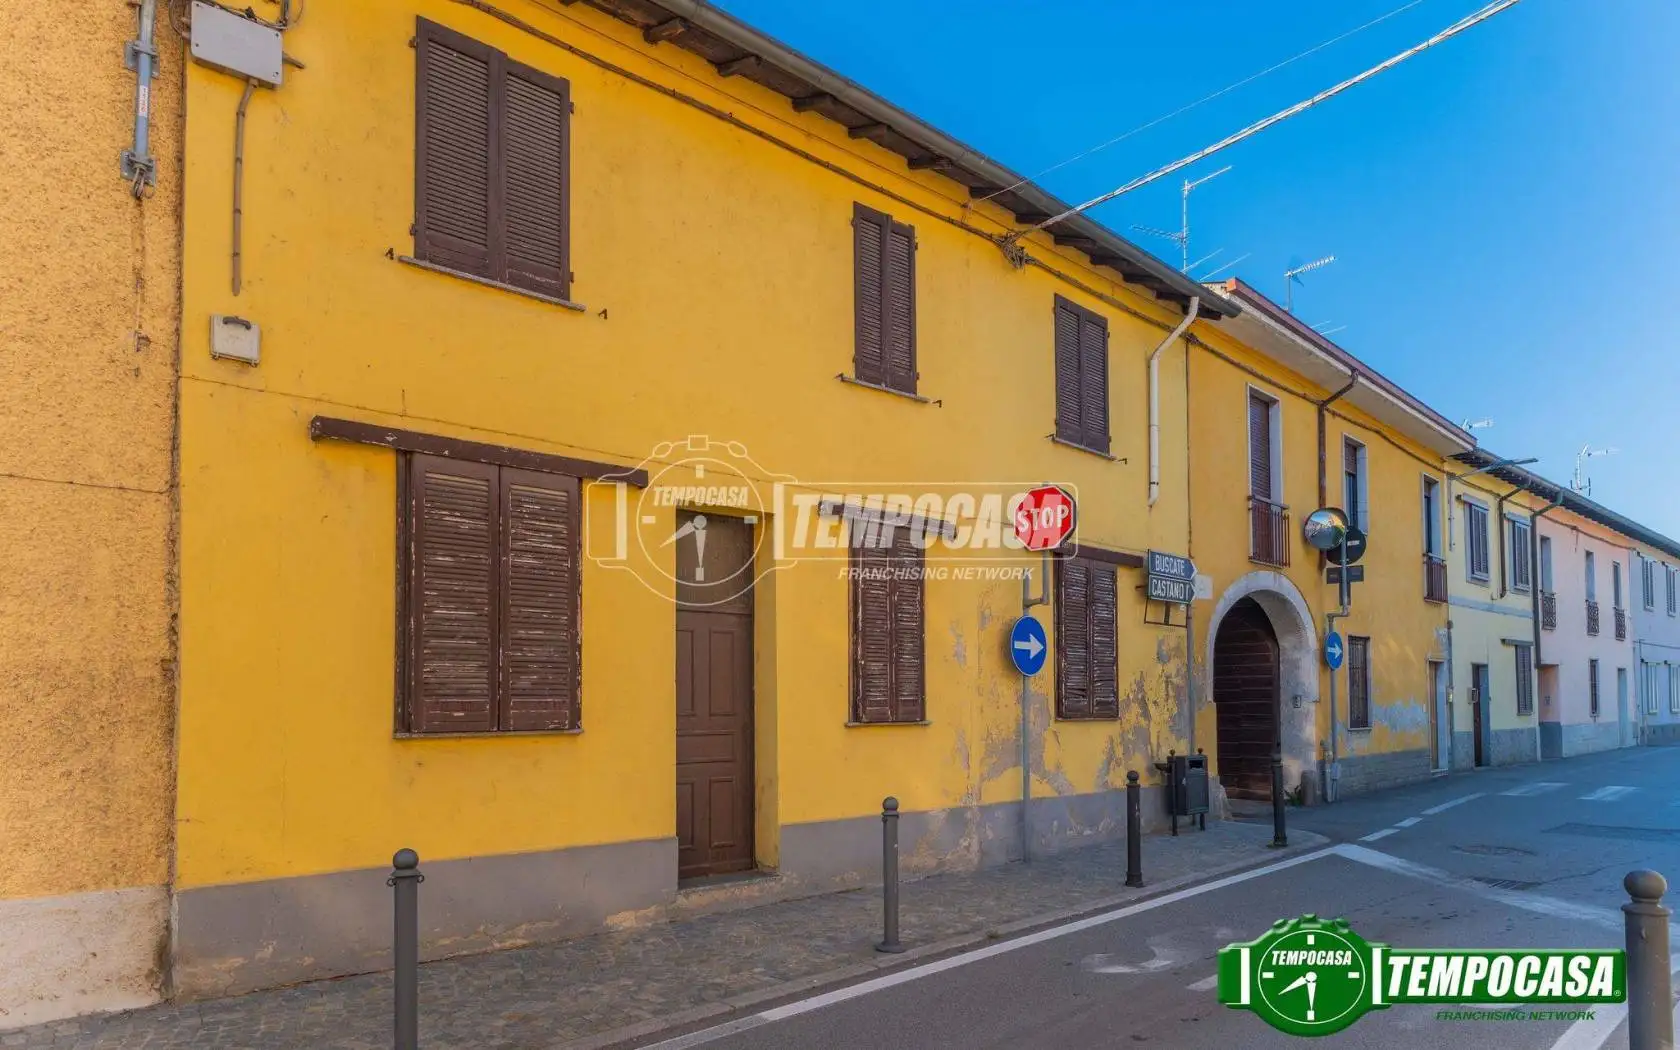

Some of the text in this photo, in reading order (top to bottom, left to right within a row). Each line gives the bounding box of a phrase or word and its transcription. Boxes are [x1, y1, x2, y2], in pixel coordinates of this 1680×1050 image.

[1017, 504, 1069, 533] STOP
[1155, 554, 1186, 576] BUSCATE
[1151, 579, 1184, 600] CASTANO
